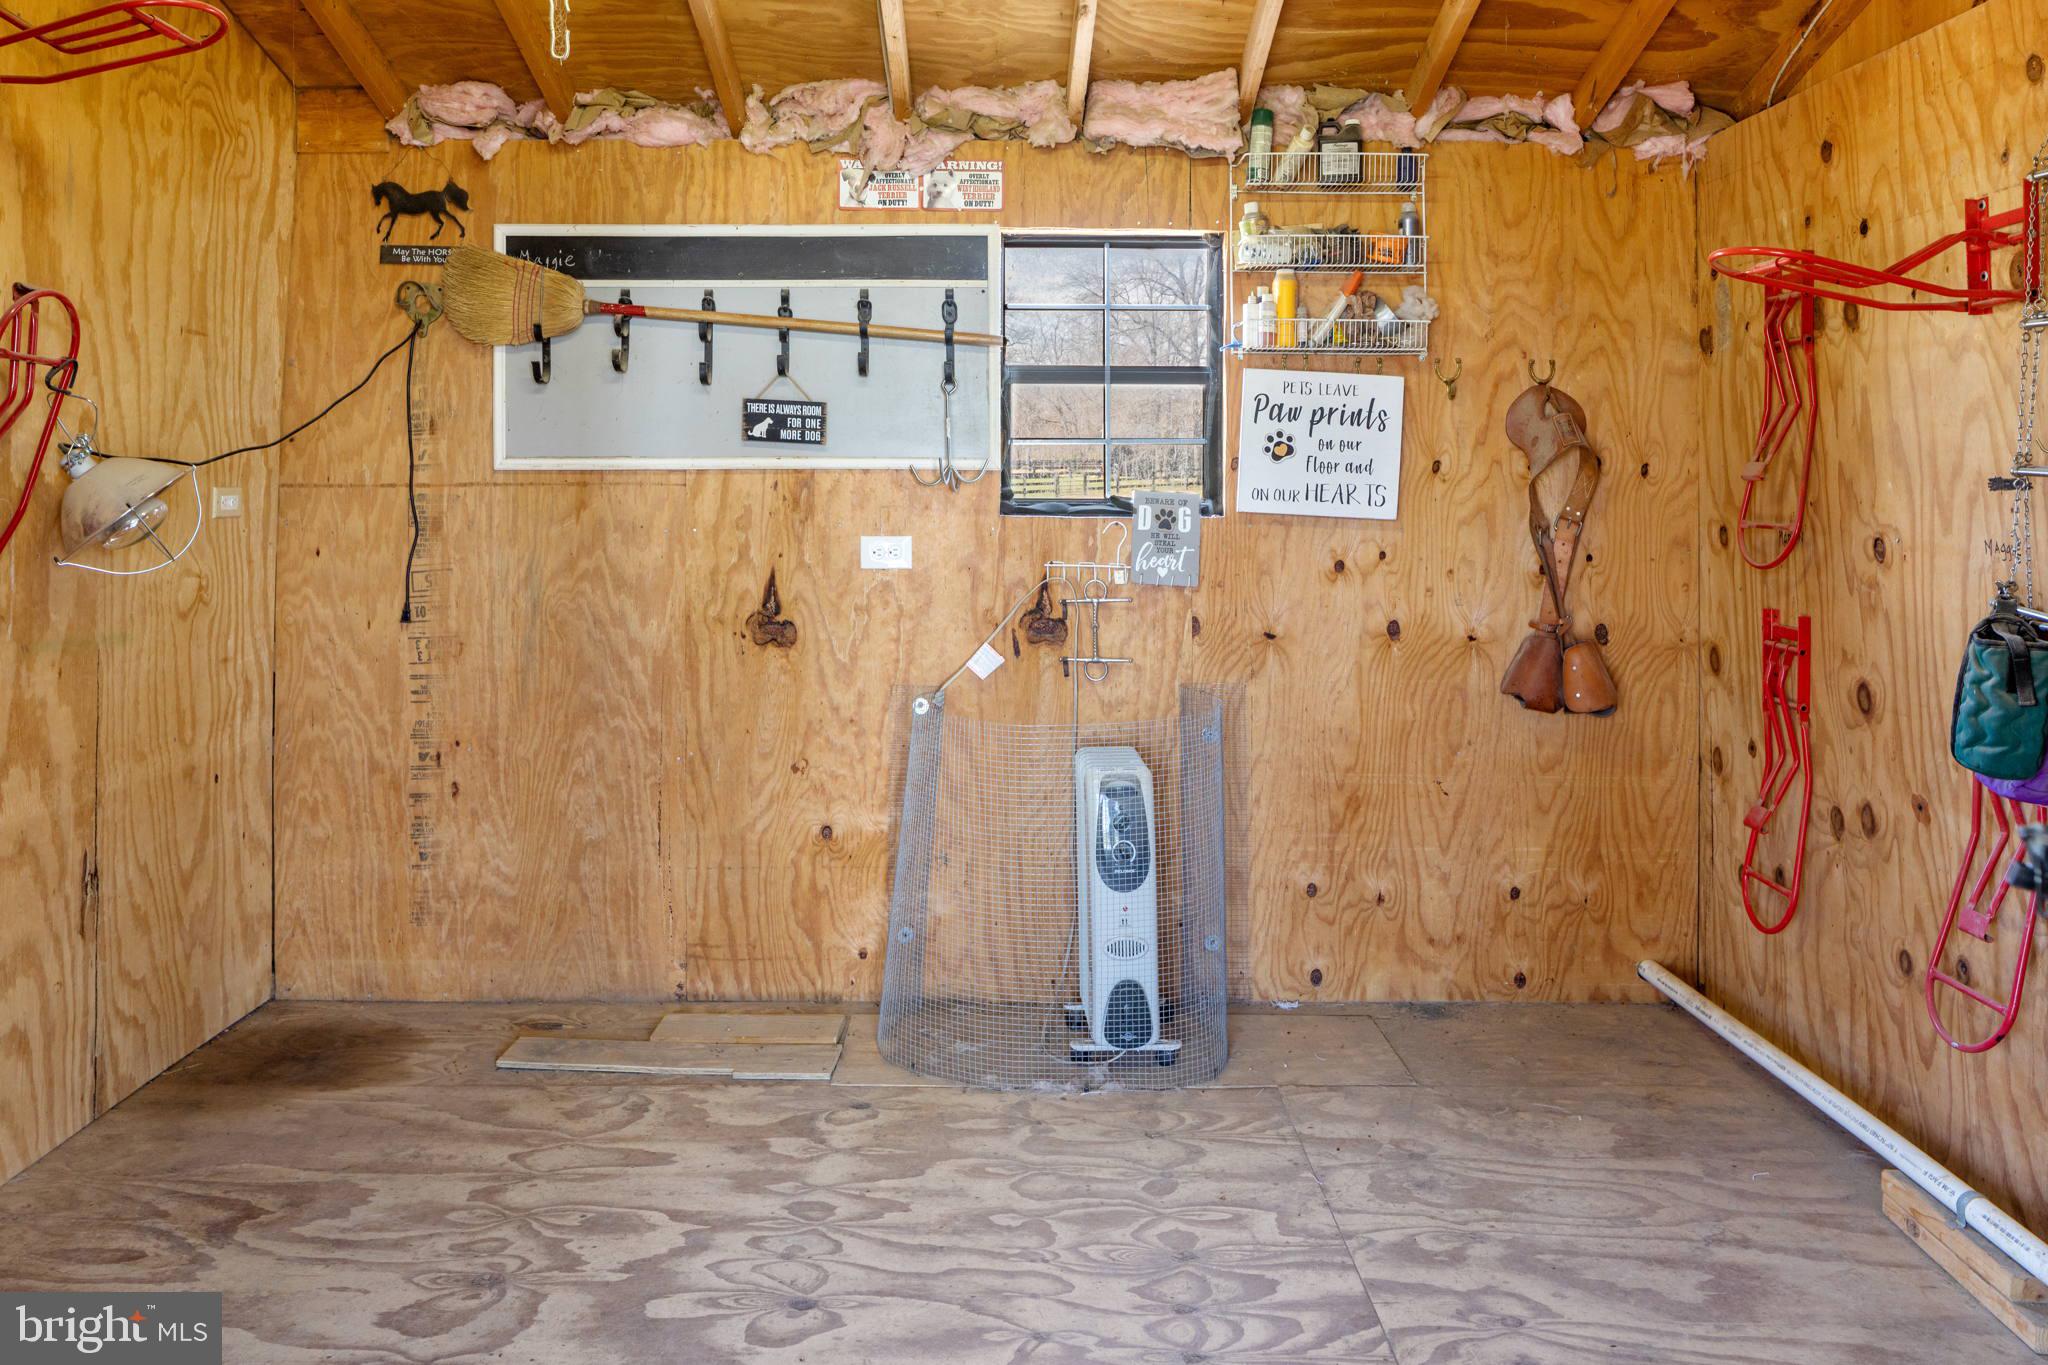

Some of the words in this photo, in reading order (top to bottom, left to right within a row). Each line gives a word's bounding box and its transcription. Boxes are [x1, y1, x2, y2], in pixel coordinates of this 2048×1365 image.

[936, 160, 1003, 170] ARNING!
[392, 248, 410, 256] May
[428, 248, 454, 256] HORS
[1282, 380, 1313, 396] PETS
[1319, 382, 1360, 397] LEAVE
[746, 402, 768, 413] THERE
[768, 403, 775, 414] IS
[776, 404, 802, 415] ALWAYS
[802, 405, 822, 416] ROOM
[1253, 393, 1303, 424] Paw
[1308, 397, 1391, 438] prints
[787, 417, 802, 428] FOR
[805, 418, 821, 429] ONE
[780, 429, 802, 440] MORE
[805, 430, 821, 441] DOG
[1318, 438, 1336, 452] on
[1339, 439, 1363, 453] our
[1306, 455, 1341, 474] Floor
[1345, 457, 1375, 476] and
[1144, 497, 1175, 506] BEWARE
[1177, 499, 1188, 507] OF
[1251, 487, 1269, 501] ON
[1273, 487, 1301, 503] OUR
[1304, 482, 1387, 508] HEARTS
[1135, 541, 1195, 572] heart
